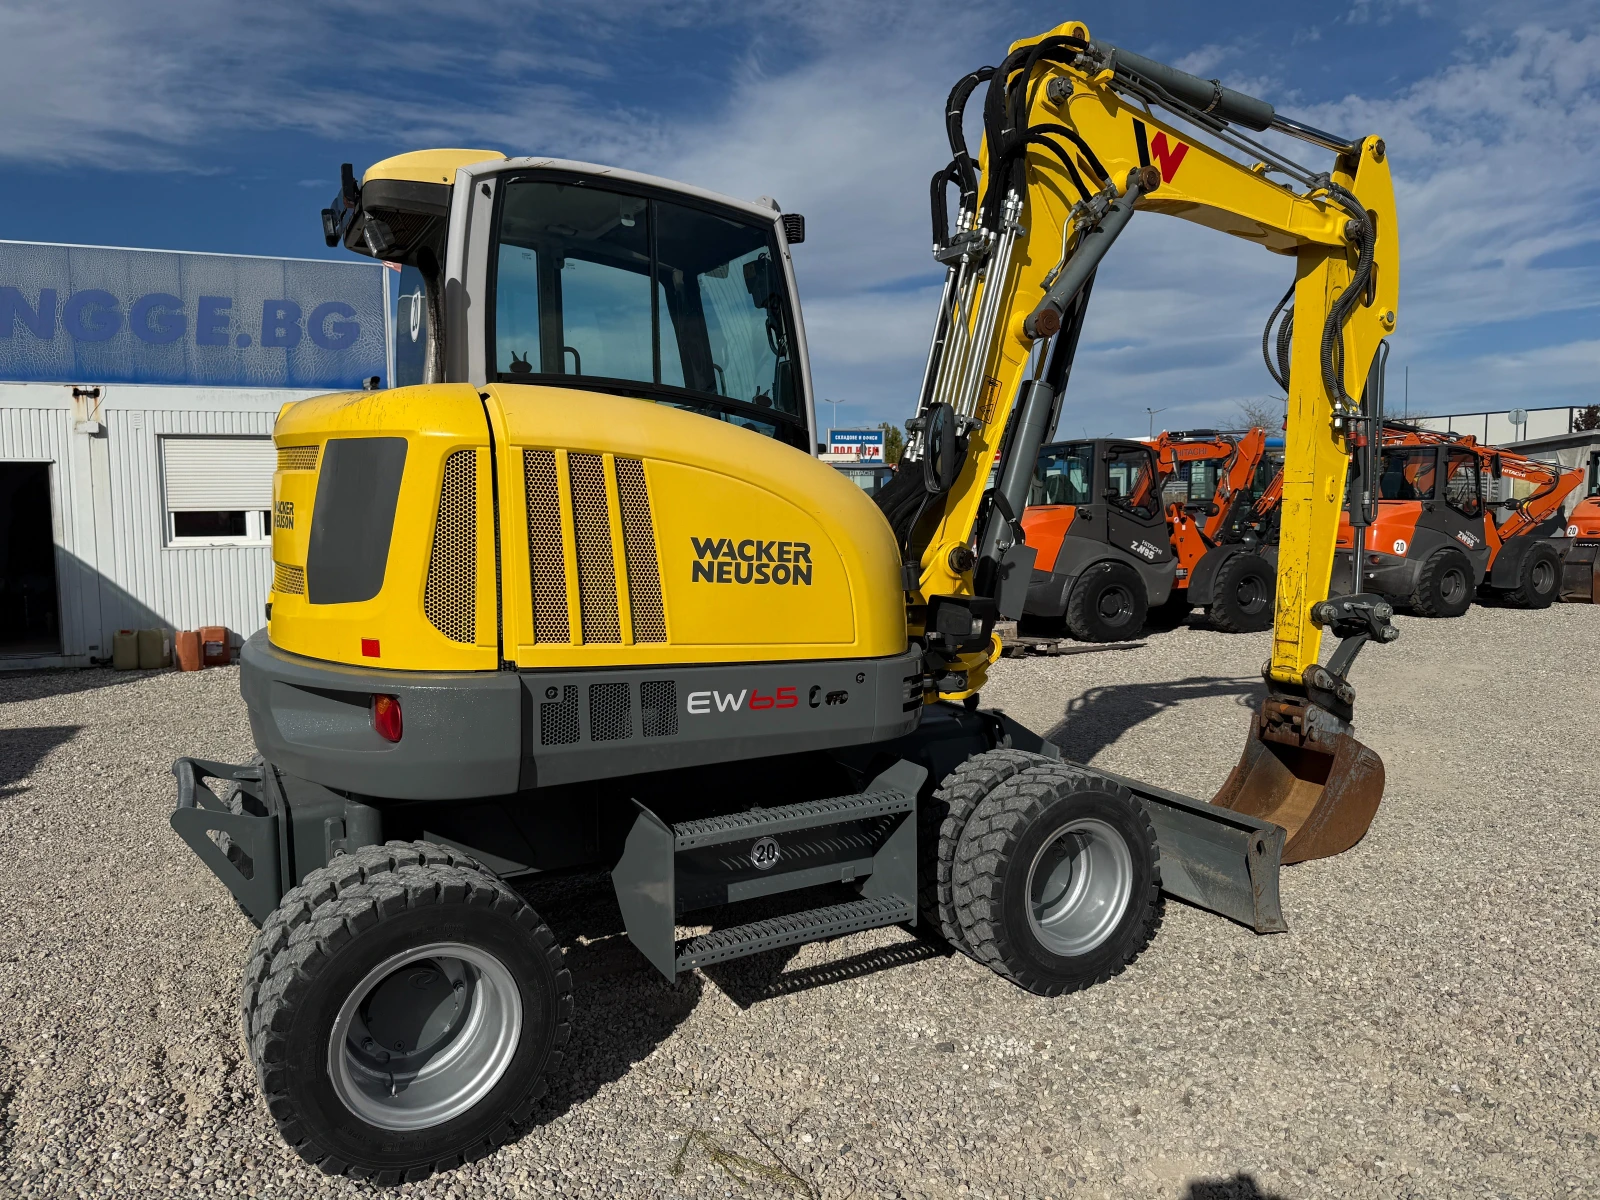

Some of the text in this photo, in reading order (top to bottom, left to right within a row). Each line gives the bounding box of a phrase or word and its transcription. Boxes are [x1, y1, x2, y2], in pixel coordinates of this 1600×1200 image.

[856, 446, 880, 456] НЕМ
[1457, 530, 1475, 547] ZW95
[1465, 530, 1480, 544] HITACHI
[1567, 527, 1577, 535] 20
[690, 536, 813, 564] WACKER
[1141, 540, 1163, 555] HITACHI
[1395, 542, 1405, 552] 20
[691, 560, 813, 586] NEUSON
[686, 686, 799, 715] EW65
[756, 843, 776, 863] 20
